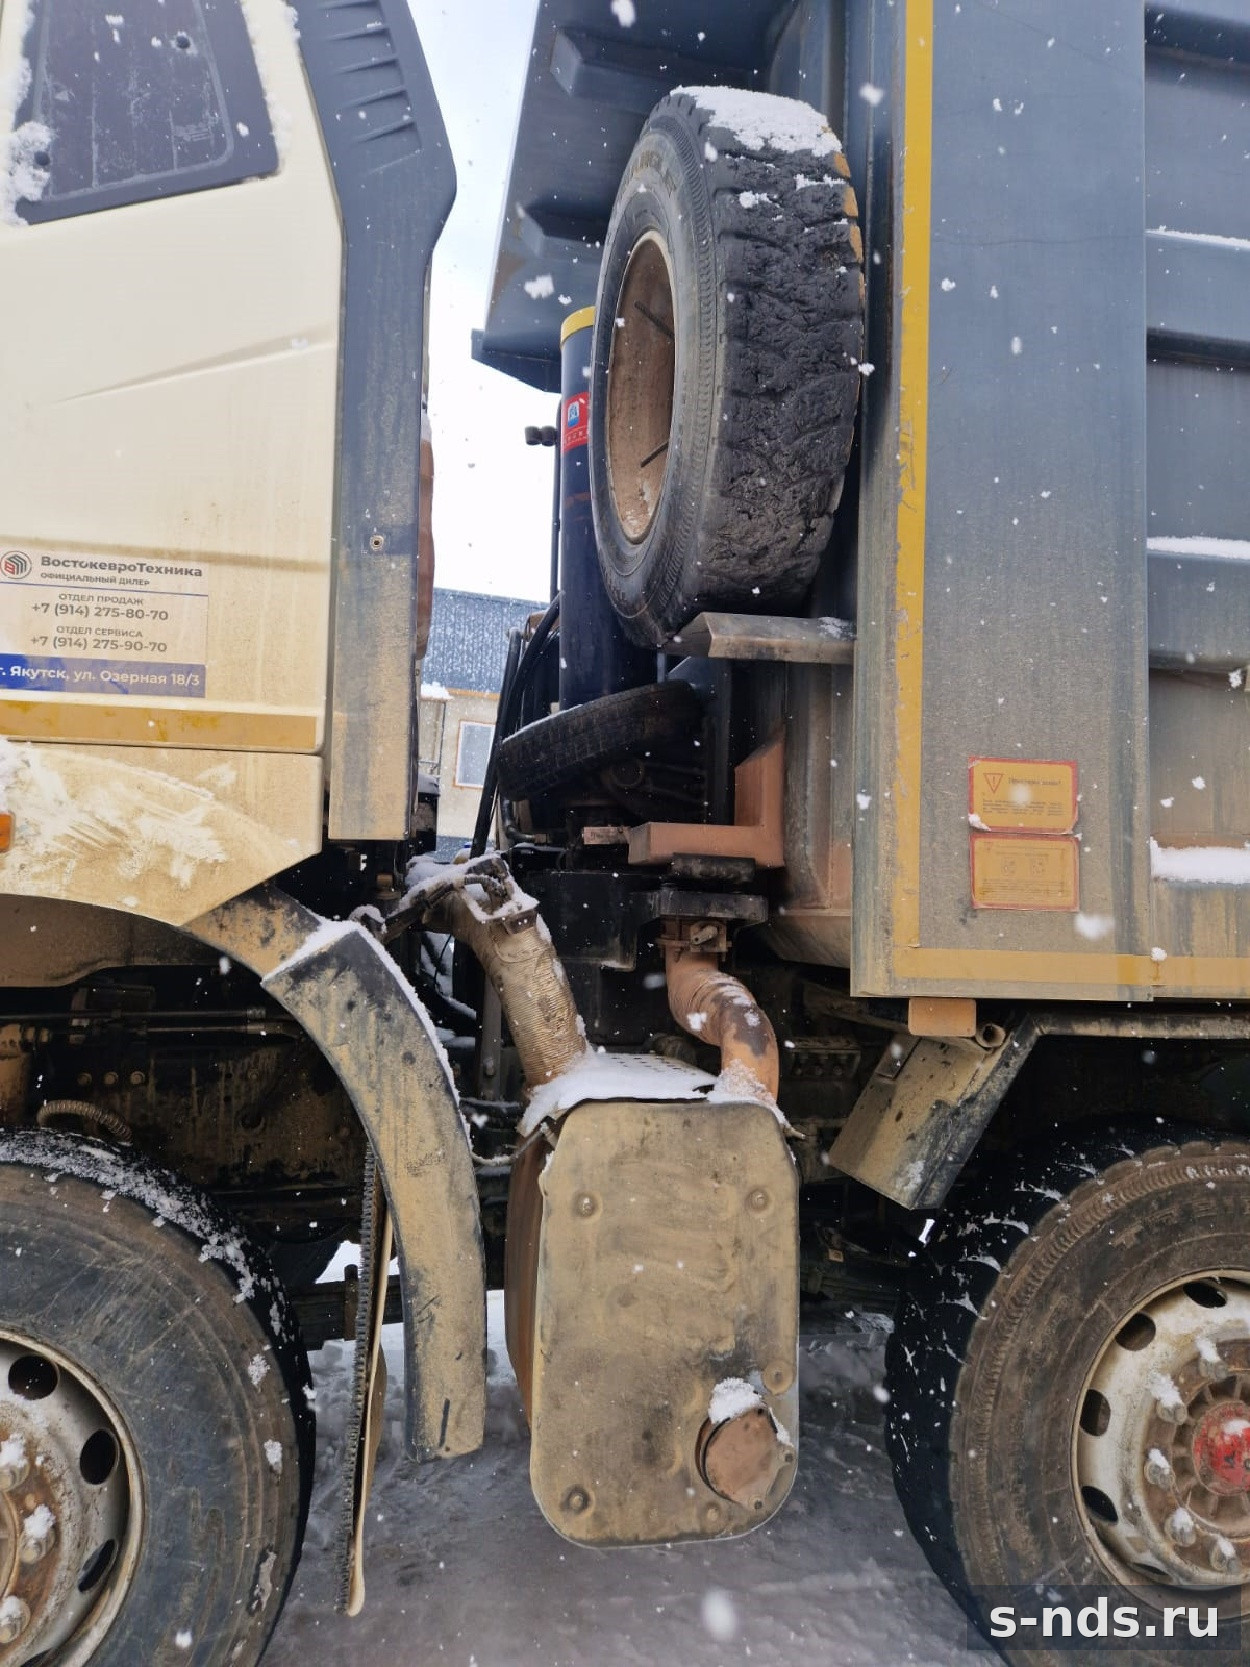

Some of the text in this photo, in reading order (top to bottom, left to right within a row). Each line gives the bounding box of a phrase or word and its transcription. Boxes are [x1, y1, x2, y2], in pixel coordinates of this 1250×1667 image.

[41, 556, 203, 577] ВостокевроТехника
[40, 572, 151, 586] ОФИЦИАЛЬНЫЙ ДИЛЕР
[58, 593, 144, 605] ОТДЕЛ ПРОДАЖ
[32, 602, 169, 621] +7 (914) 275-80-70
[56, 625, 143, 638] ОТДЕЛ СЕРВИСА
[30, 635, 168, 652] +7 (914) 275-90-70
[10, 665, 70, 680] Якутск,
[74, 670, 96, 683] ул.
[100, 669, 167, 685] Озерная
[172, 673, 200, 686] 18/3
